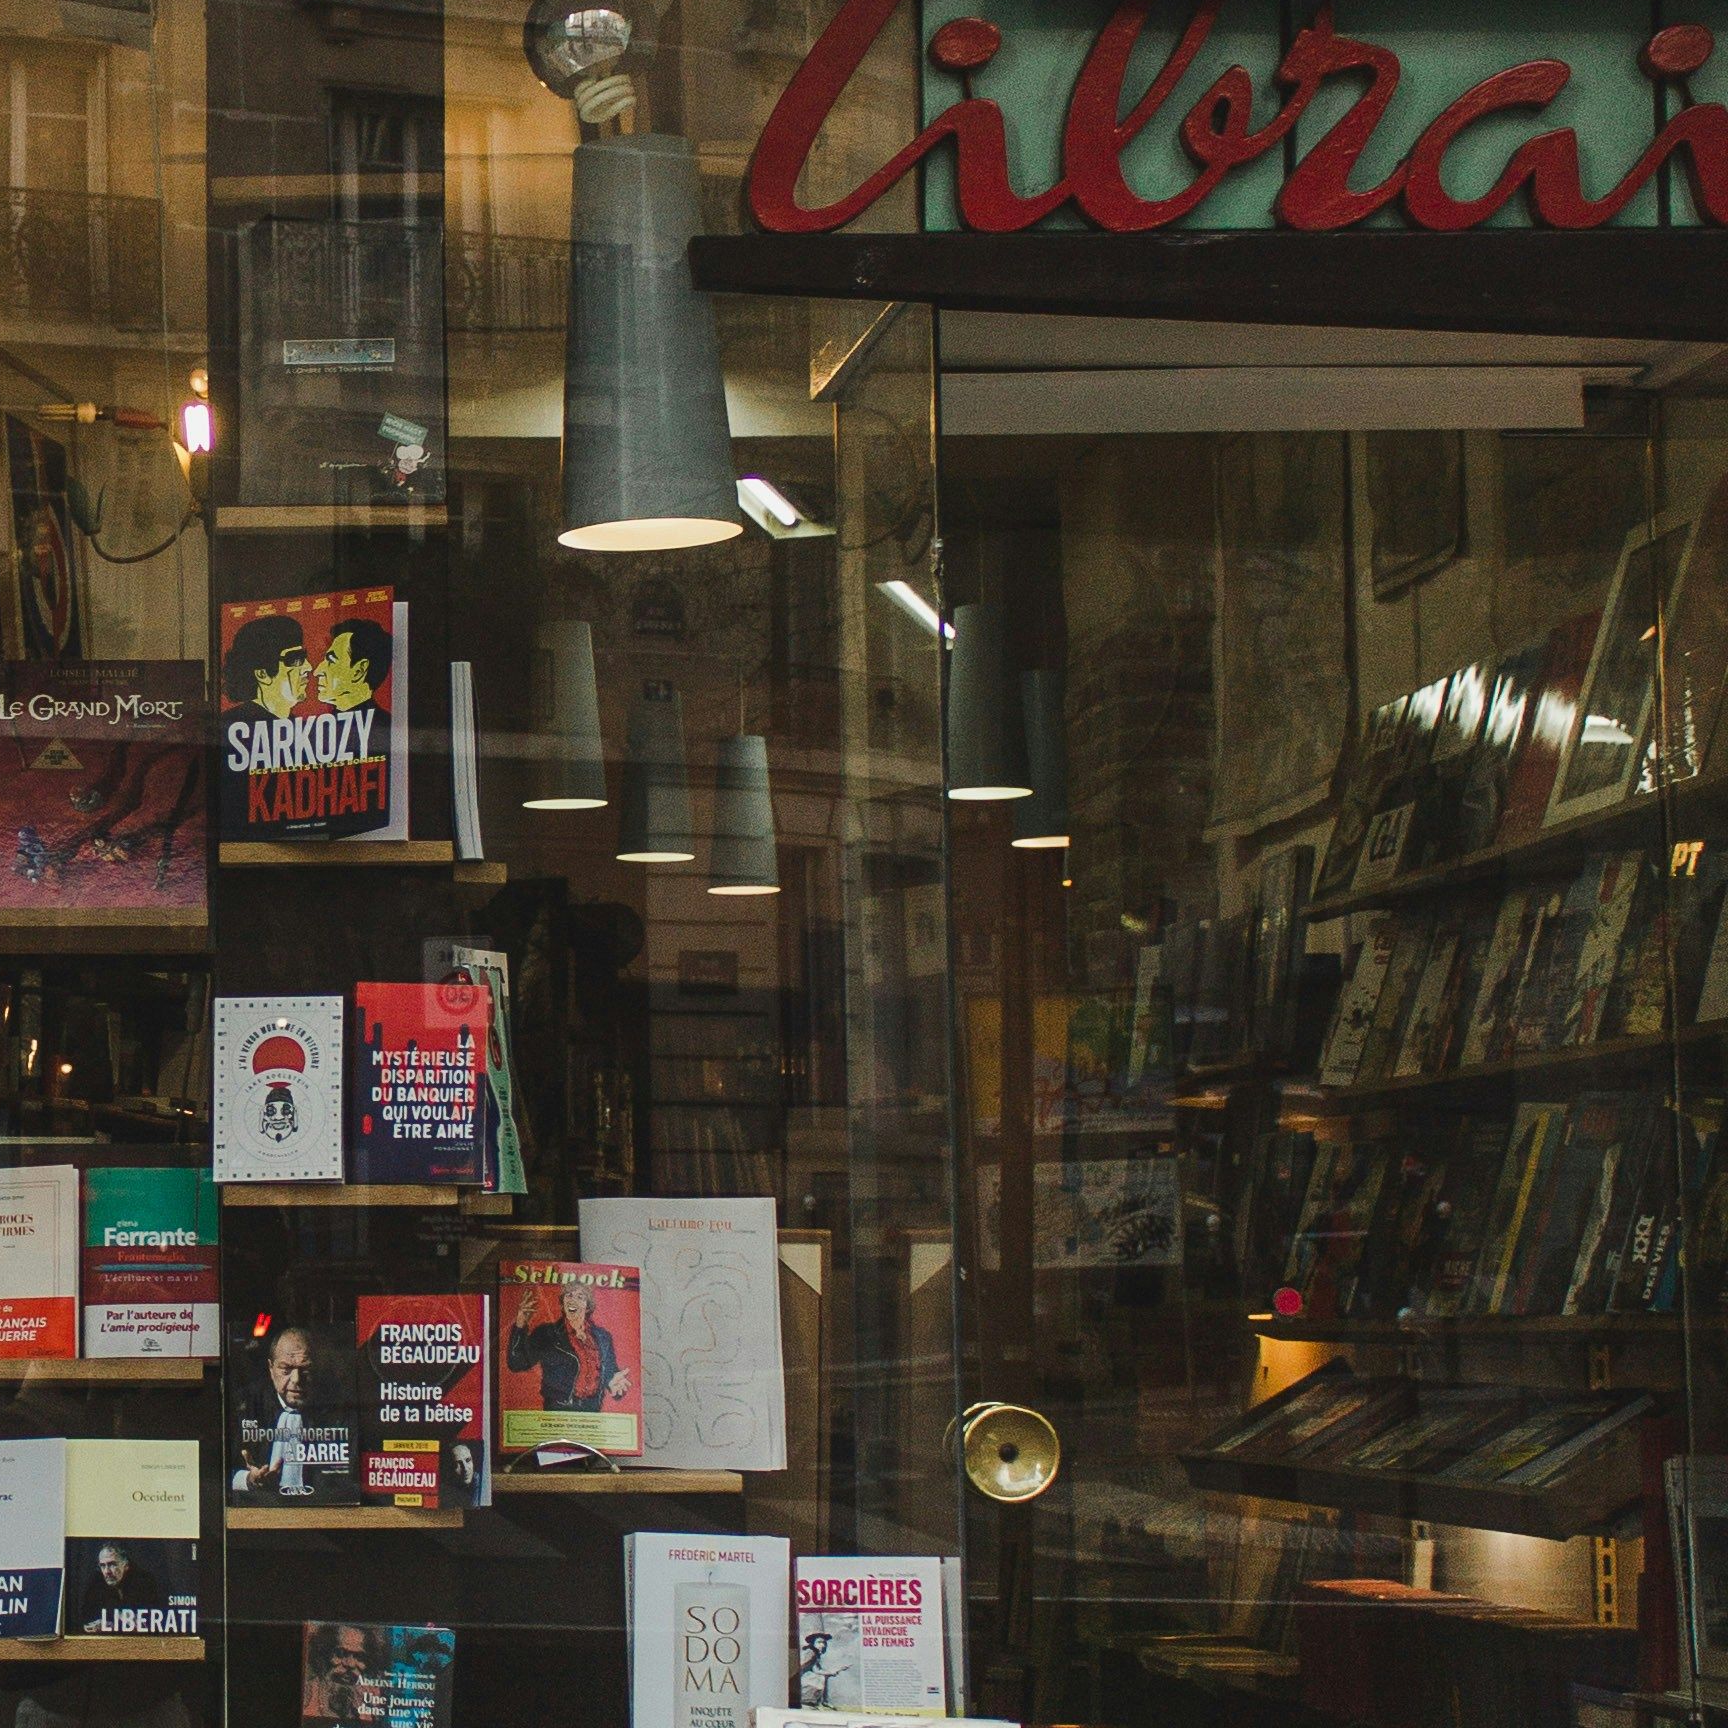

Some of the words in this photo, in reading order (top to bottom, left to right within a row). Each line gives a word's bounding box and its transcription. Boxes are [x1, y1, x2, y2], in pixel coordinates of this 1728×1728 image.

[28, 693, 110, 721] GRAND
[108, 693, 183, 735] MORT
[228, 708, 375, 773] SARKOZY
[248, 759, 387, 823] KADHAFI
[457, 1034, 475, 1049] LA
[372, 1045, 475, 1067] MYSTÉRIEUSE
[380, 1069, 475, 1085] DISPARITION
[372, 1087, 393, 1102] DU
[396, 1087, 475, 1104] BANQUIER
[383, 1105, 408, 1121] QUI
[104, 1227, 198, 1247] Ferrante
[513, 1264, 627, 1289] Schnock
[106, 1311, 124, 1320] Par
[127, 1310, 177, 1319] l'auteure
[179, 1309, 194, 1319] de
[100, 1322, 134, 1333] L'amie
[137, 1322, 200, 1334] prodigieuse
[380, 1323, 462, 1347] FRANÇOIS
[380, 1341, 480, 1364] BÉGAUDEAU
[380, 1381, 443, 1401] Histoire
[379, 1403, 400, 1422] de
[404, 1405, 420, 1422] ta
[424, 1403, 473, 1422] bêtise
[242, 1418, 258, 1429] ÉRIC
[296, 1443, 349, 1462] BARRE
[368, 1457, 414, 1472] FRANÇOIS
[368, 1470, 436, 1487] BÉGAUDEAU
[132, 1491, 185, 1503] Occident
[668, 1548, 715, 1562] FRÉDÉRIC
[718, 1551, 756, 1564] MARTEL
[796, 1573, 922, 1606] SORCIÈRES
[168, 1595, 197, 1606] SIMON
[101, 1608, 197, 1634] LIBERATI
[686, 1605, 741, 1635] SO
[861, 1615, 872, 1625] LA
[875, 1615, 922, 1626] PUISSANCE
[862, 1627, 908, 1637] INVAINCUE
[684, 1635, 741, 1664] DO
[863, 1638, 879, 1647] DES
[881, 1638, 915, 1647] FEMMES
[684, 1666, 741, 1694] MA
[363, 1692, 387, 1705] Une
[389, 1695, 435, 1708] journée
[357, 1703, 385, 1716] dans
[388, 1707, 411, 1718] une
[413, 1708, 434, 1720] vie,
[690, 1704, 732, 1717] ENQUÊTE
[689, 1718, 703, 1728] AU
[705, 1718, 735, 1728] CŒUR
